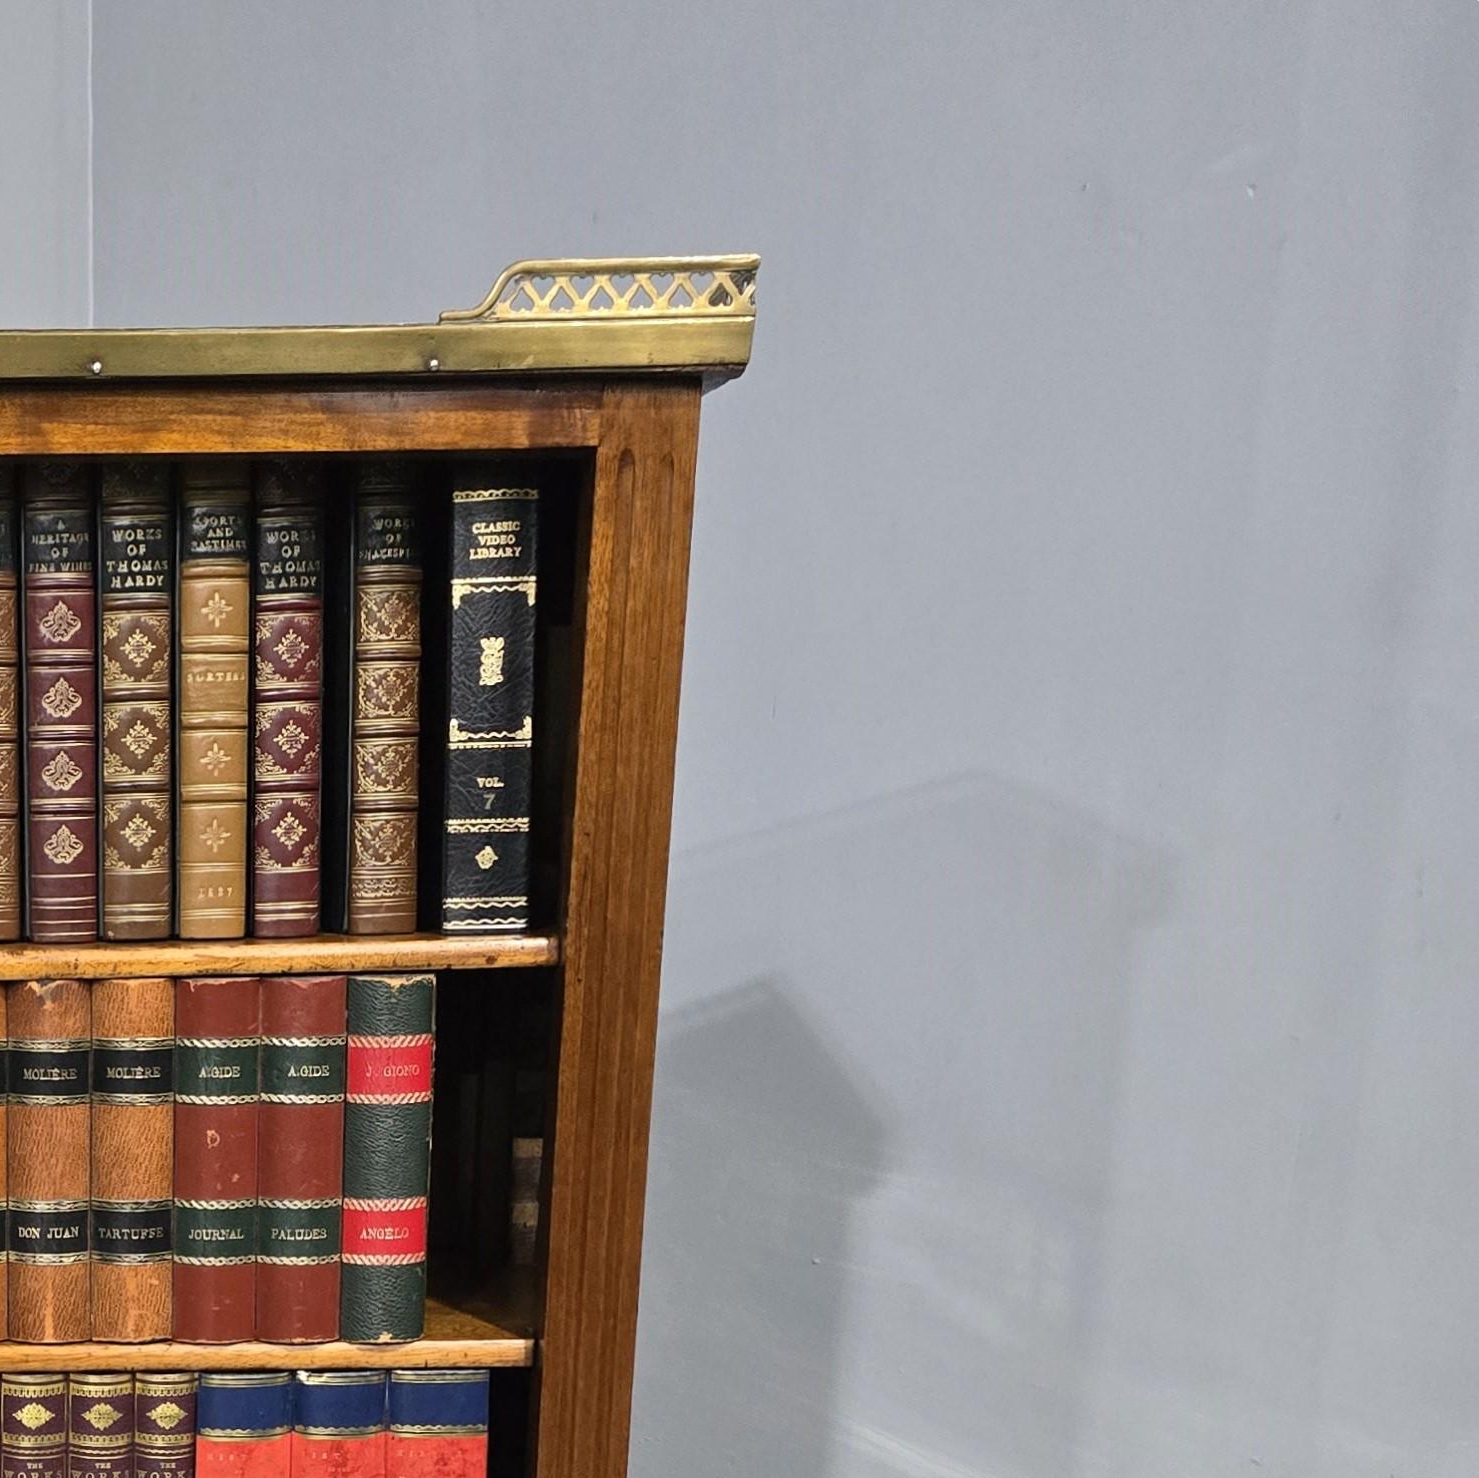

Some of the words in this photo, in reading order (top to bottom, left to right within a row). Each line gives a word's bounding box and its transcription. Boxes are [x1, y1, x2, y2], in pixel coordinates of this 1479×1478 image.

[207, 527, 234, 538] AND
[472, 521, 521, 534] CLASSIC
[112, 529, 162, 543] WORKS
[477, 534, 516, 546] VIDEO
[51, 547, 69, 558] OF
[127, 544, 147, 556] OF
[281, 545, 301, 558] OF
[469, 546, 522, 559] LIBRARY
[106, 560, 168, 573] THOMAS
[111, 575, 164, 588] HARDY
[265, 576, 317, 589] HARDY
[476, 777, 504, 788] VOL.
[483, 793, 496, 810] 7
[198, 1065, 241, 1078] A.GIDE
[288, 1065, 330, 1077] A.GIDE
[383, 1065, 420, 1077] GIONO
[18, 1226, 41, 1239] DON
[47, 1226, 80, 1239] JUAN
[98, 1227, 164, 1240] TARTUFFE
[188, 1228, 244, 1241] JOURNAL
[271, 1228, 328, 1240] PALUDES
